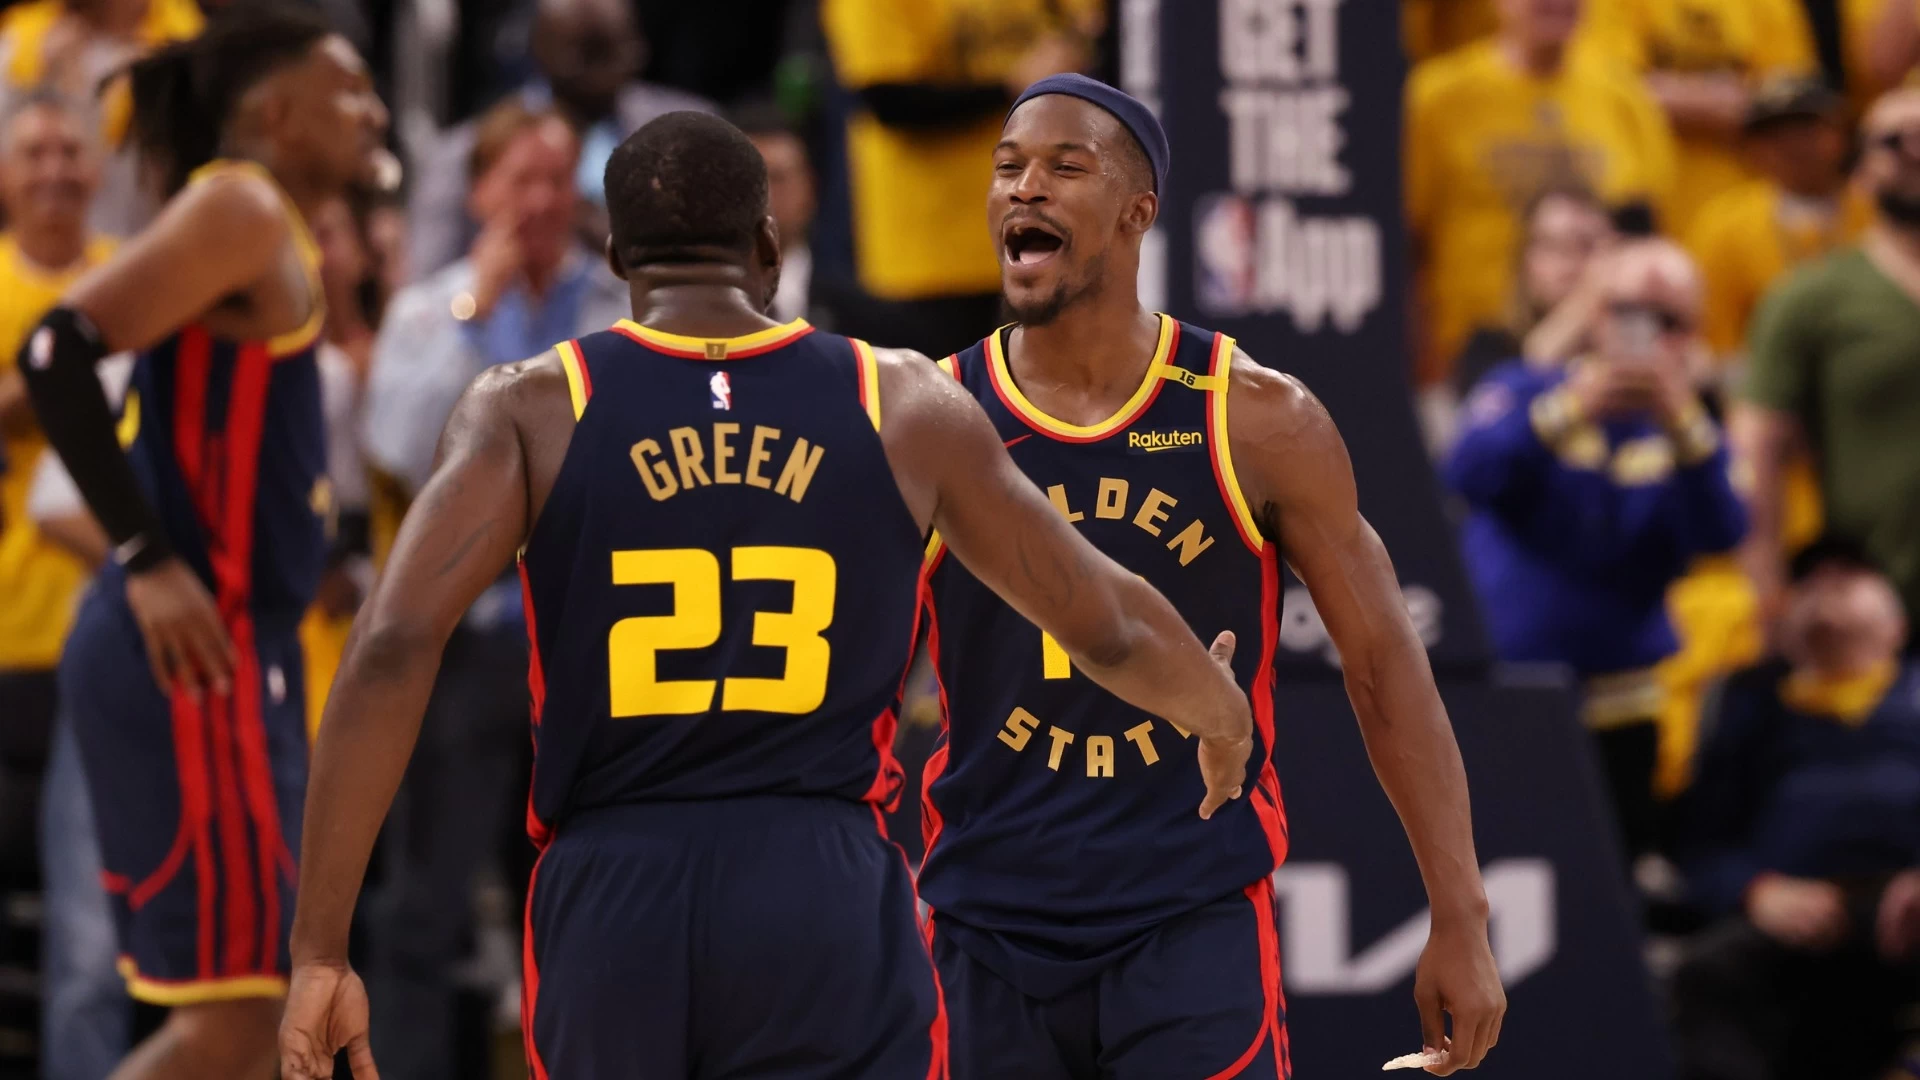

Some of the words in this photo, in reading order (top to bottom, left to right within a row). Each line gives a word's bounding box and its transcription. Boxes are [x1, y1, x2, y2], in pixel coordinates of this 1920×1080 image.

[1218, 0, 1340, 80] GET
[1219, 87, 1351, 194] THE
[1179, 371, 1196, 386] 16
[629, 422, 826, 503] GREEN
[1128, 430, 1202, 448] Rakuten
[1047, 477, 1215, 567] LDEN
[608, 546, 837, 718] 23
[997, 706, 1192, 778] STAT
